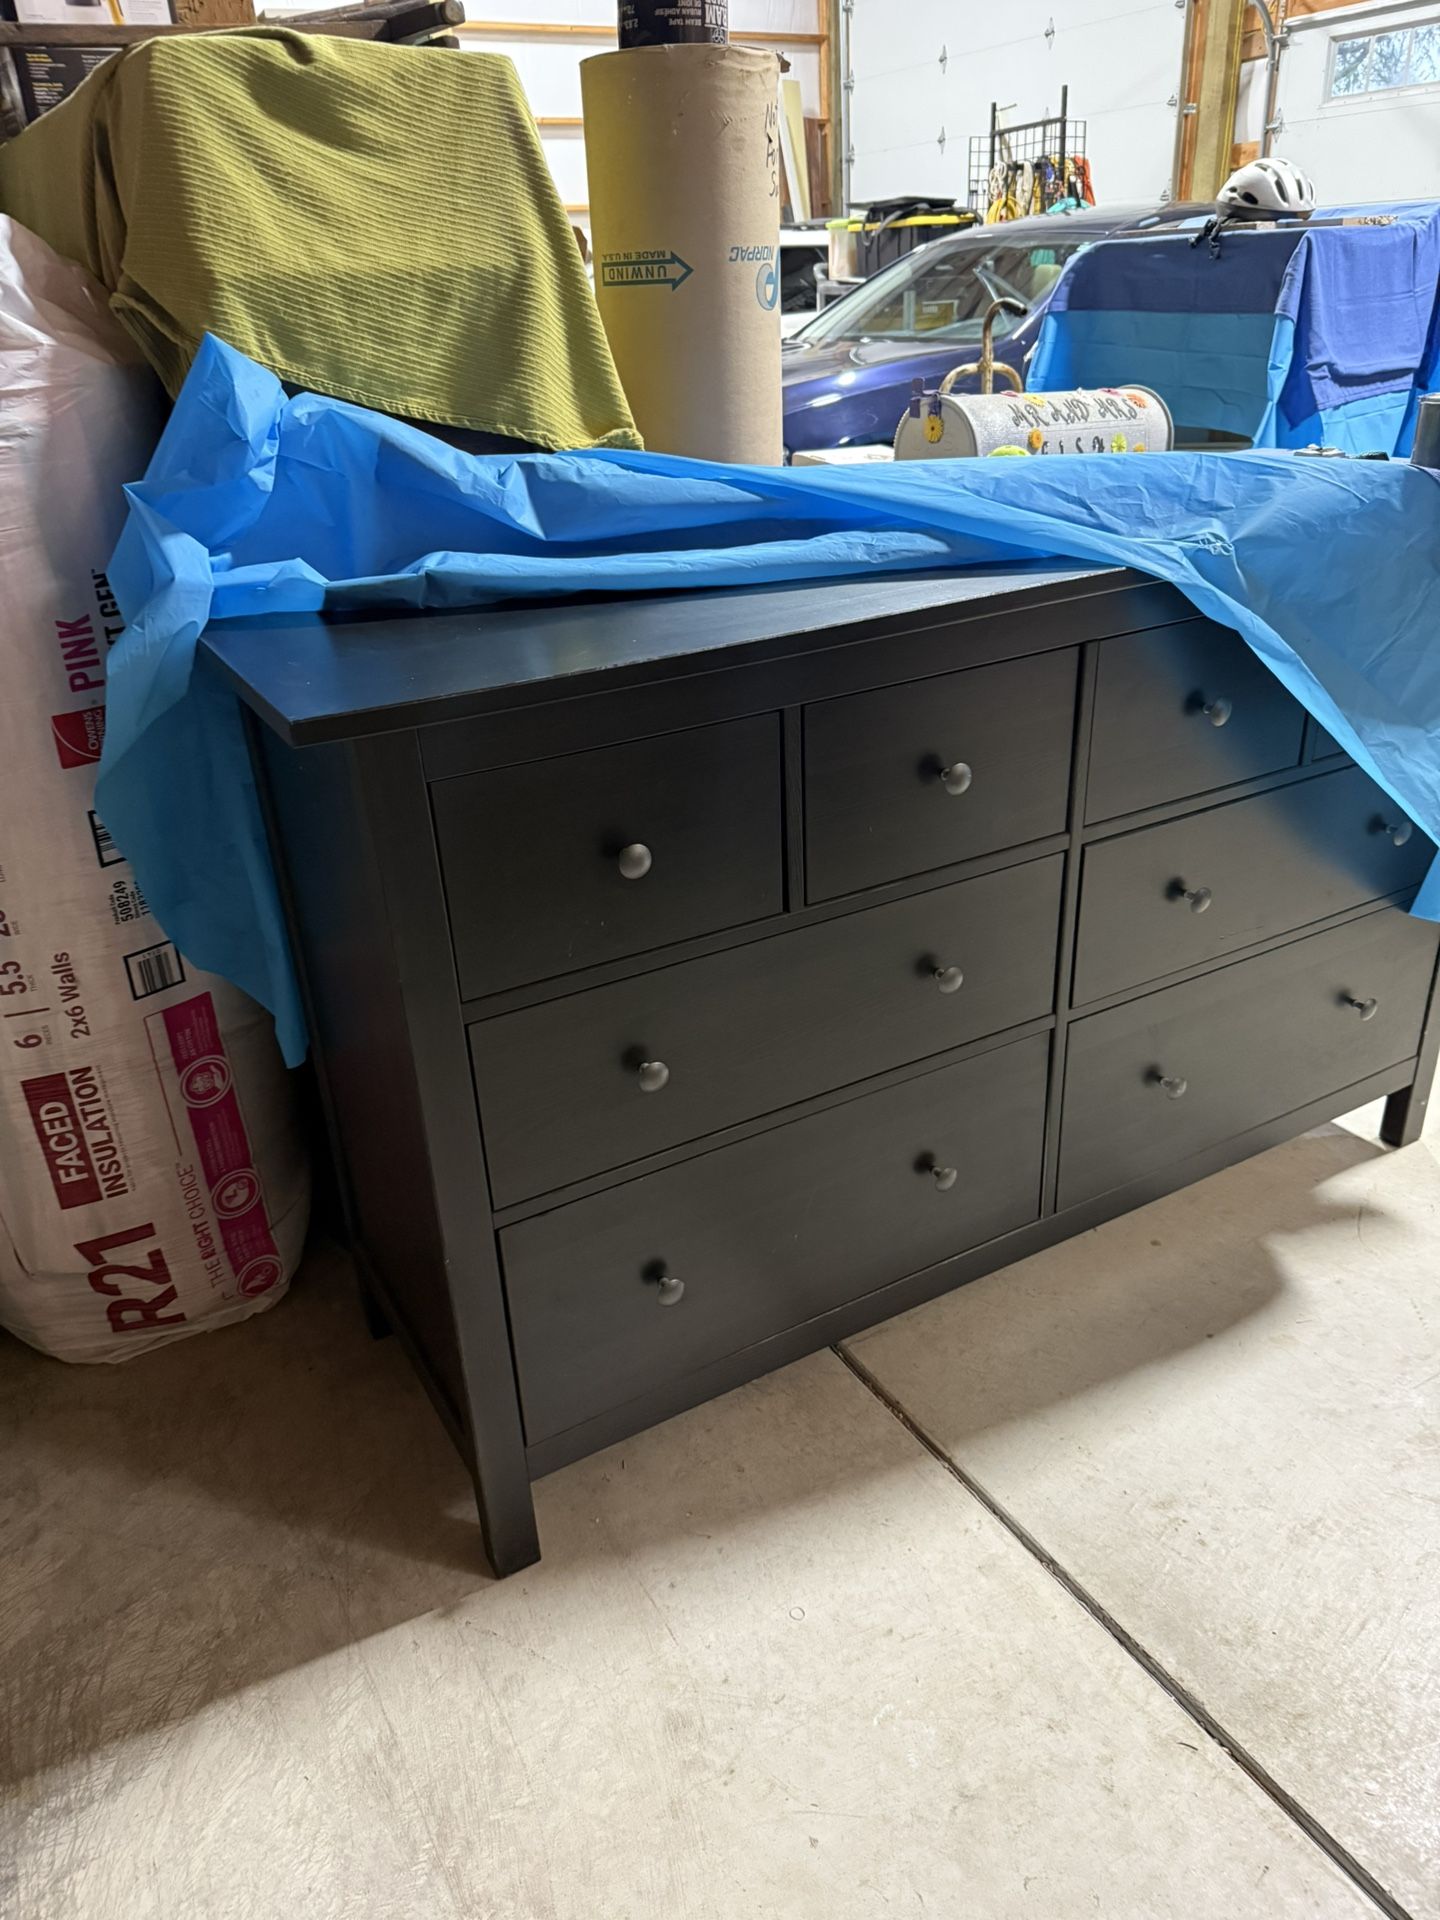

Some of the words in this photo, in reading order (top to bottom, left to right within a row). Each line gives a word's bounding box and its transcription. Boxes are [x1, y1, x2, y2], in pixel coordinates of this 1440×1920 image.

[668, 18, 684, 26] TAPE
[624, 252, 633, 261] IN
[635, 250, 666, 259] MADE
[729, 246, 774, 262] NORPAC
[608, 265, 667, 281] UNWIND
[55, 613, 106, 693] PINK
[83, 711, 99, 750] OWENS
[113, 881, 134, 922] 508249
[0, 961, 27, 995] 5.5
[50, 952, 80, 1003] Walls
[64, 1005, 91, 1039] 2x6
[13, 1034, 42, 1049] 6
[39, 1101, 89, 1184] FACED
[69, 1066, 128, 1198] INSULATION
[192, 1221, 217, 1261] RIGHT
[74, 1222, 188, 1333] R21
[204, 1258, 225, 1289] THE
